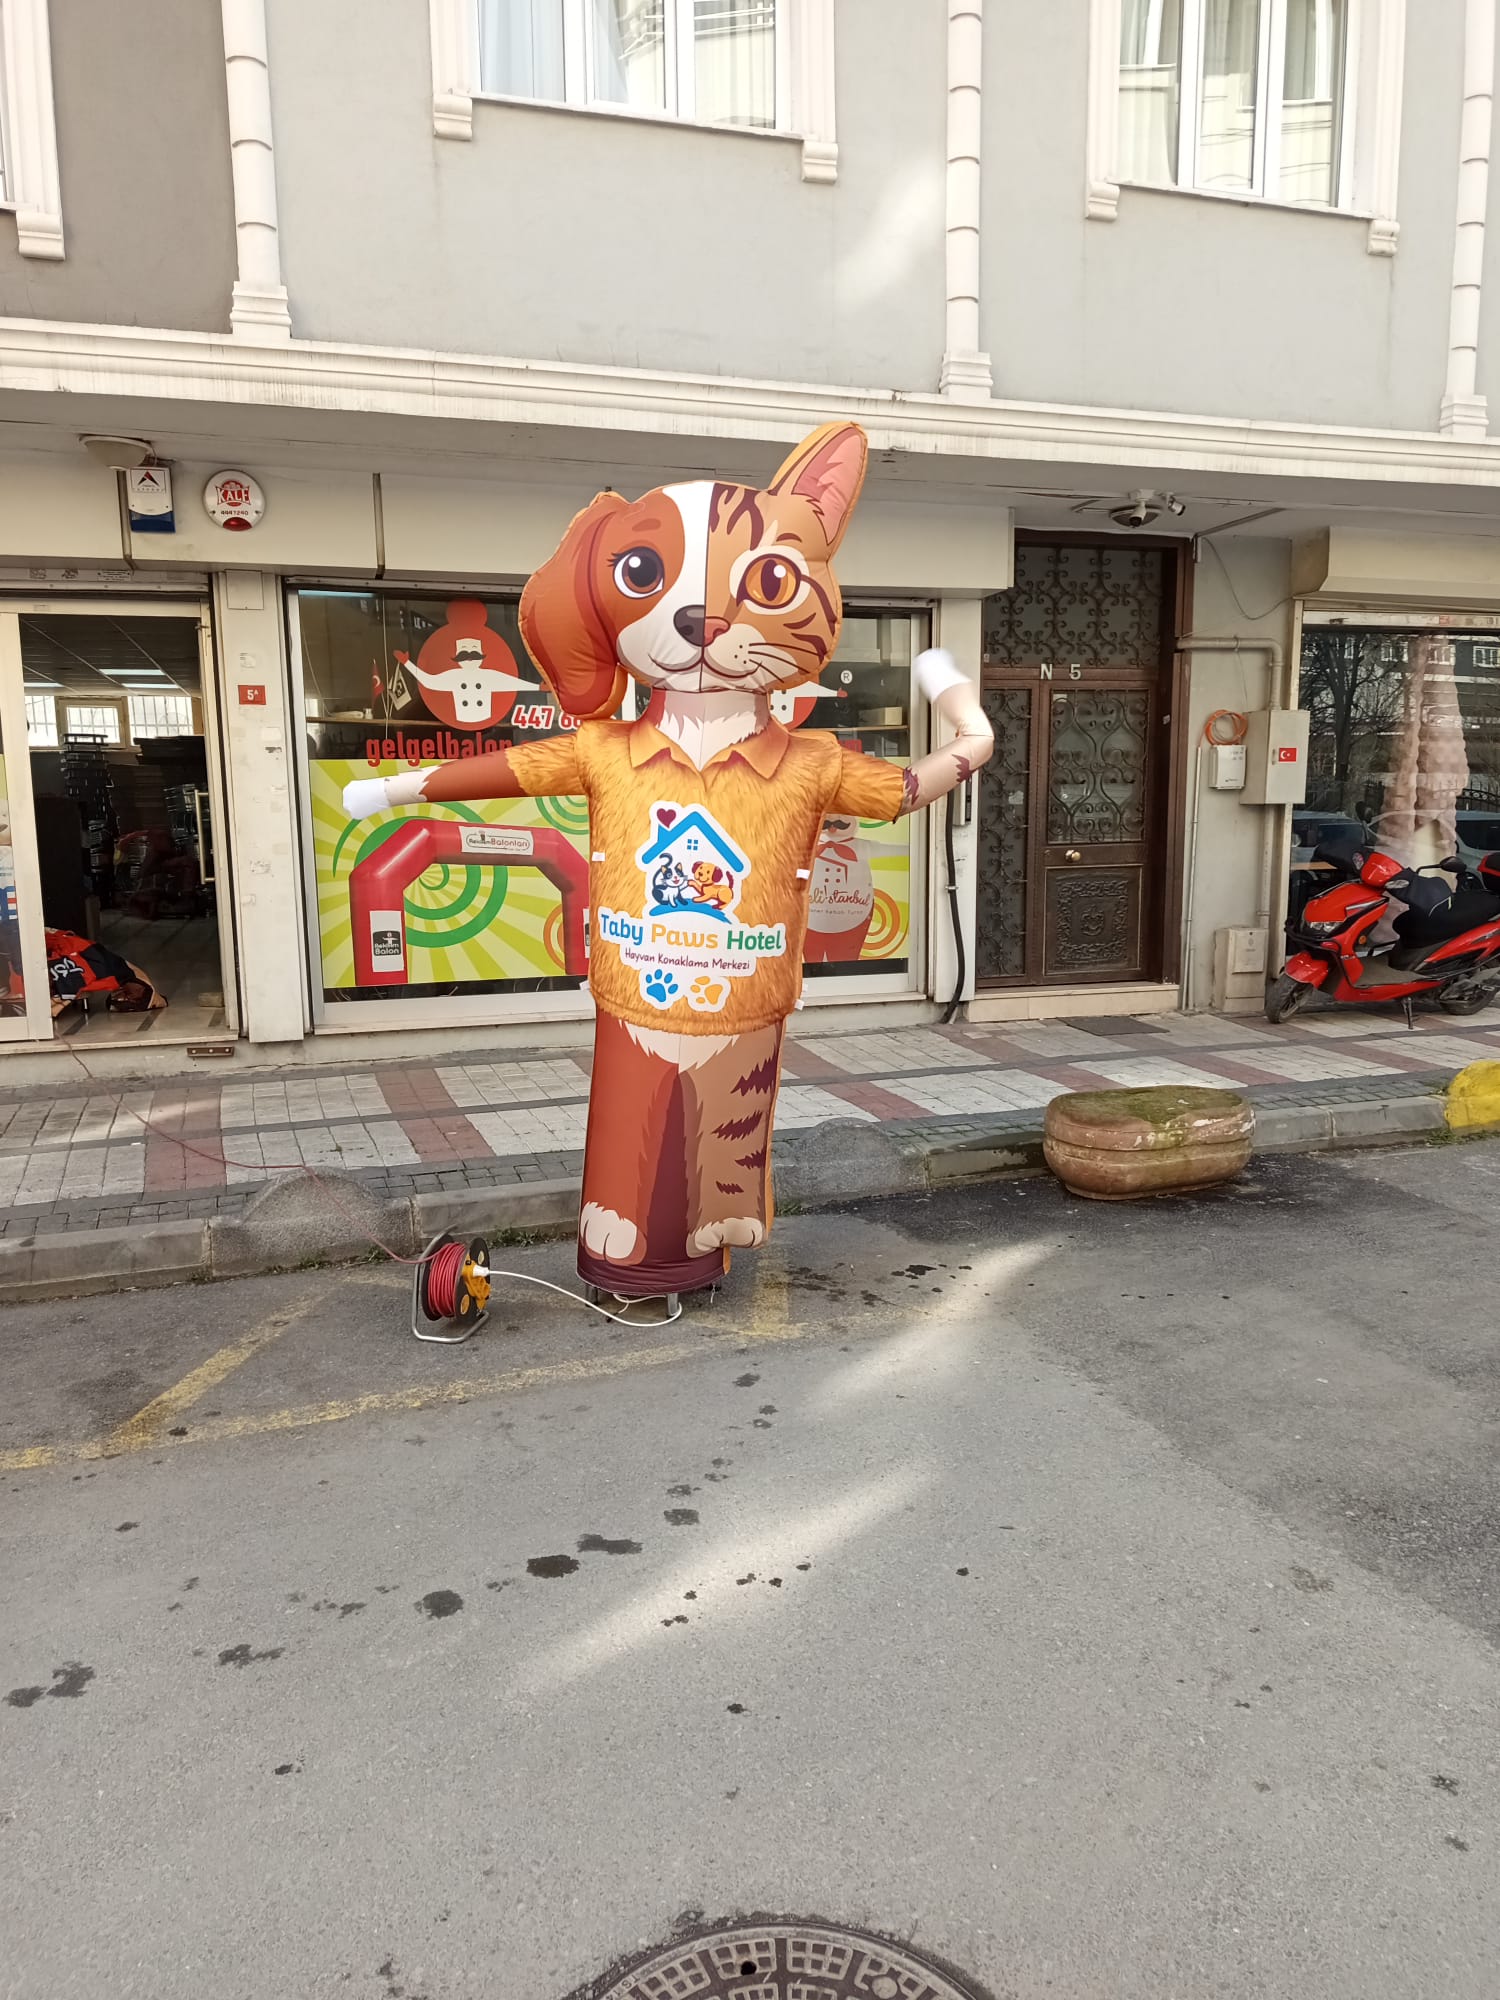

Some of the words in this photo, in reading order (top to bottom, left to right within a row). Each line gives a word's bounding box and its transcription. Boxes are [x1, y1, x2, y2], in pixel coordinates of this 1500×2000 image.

[217, 487, 250, 504] KALE
[1040, 663, 1053, 680] N
[1069, 663, 1082, 680] 5
[512, 706, 554, 729] 447
[366, 731, 533, 768] gelgelbalon
[601, 914, 643, 945] Taby
[651, 924, 718, 949] Paws
[727, 930, 782, 950] Hotel
[625, 948, 655, 964] Hayvan
[658, 954, 709, 968] Konaklama
[712, 959, 750, 970] Merkezi
